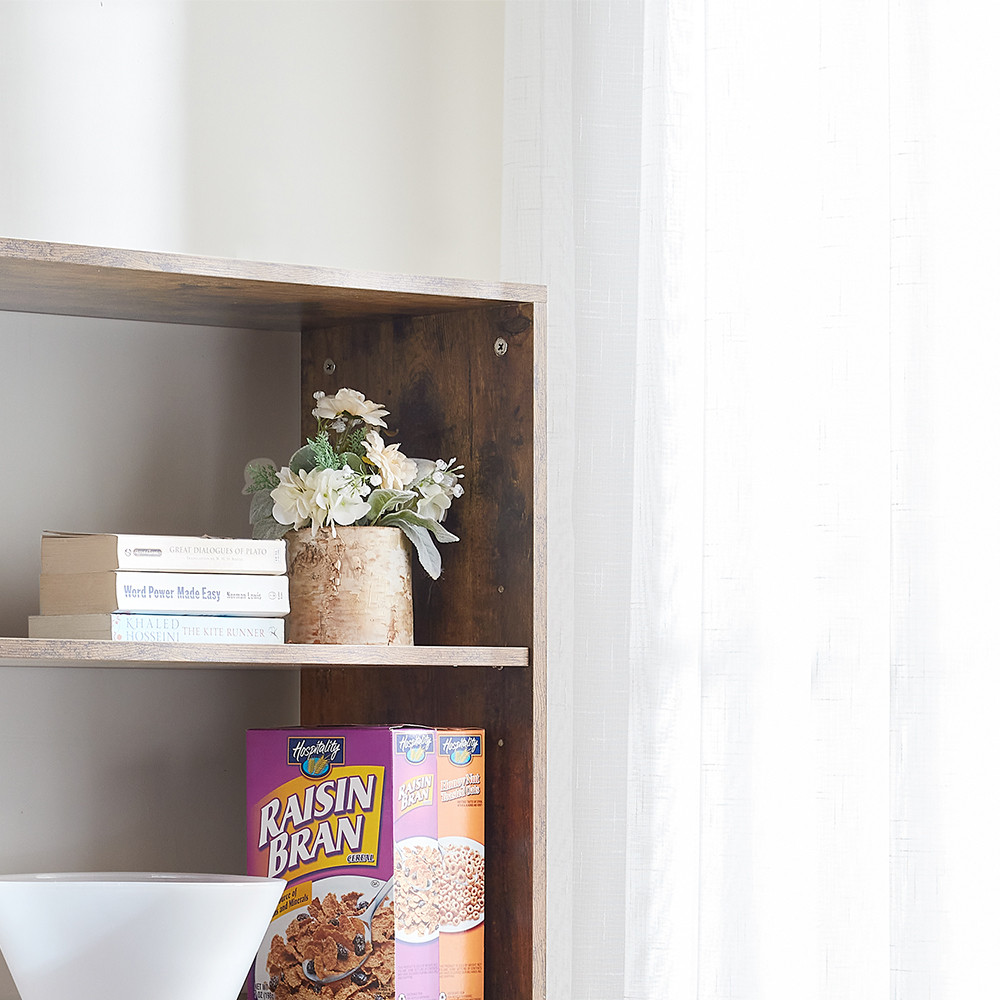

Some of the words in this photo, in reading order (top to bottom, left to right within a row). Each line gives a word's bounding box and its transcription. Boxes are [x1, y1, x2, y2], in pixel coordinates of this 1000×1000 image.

[169, 546, 191, 554] GREAT
[193, 546, 233, 555] DIALOGUES
[234, 547, 243, 555] OF
[245, 547, 268, 556] PLATO
[124, 585, 146, 598] Word
[148, 585, 174, 599] Power
[177, 586, 200, 600] Made
[202, 587, 221, 602] Easy
[126, 618, 180, 630] KHALED
[182, 626, 200, 636] THE
[203, 627, 223, 636] KITE
[226, 628, 265, 638] RUNNER
[126, 630, 180, 642] HOSSEINI
[292, 739, 340, 762] Hospitality
[399, 734, 432, 751] Hospitality
[442, 737, 479, 754] Hospitality
[398, 775, 432, 802] RAISIN
[401, 788, 430, 812] BRAN
[258, 774, 375, 848] RAISIN
[267, 814, 363, 878] BRAN
[346, 854, 375, 864] CEREAL
[289, 893, 309, 908] Minerals
